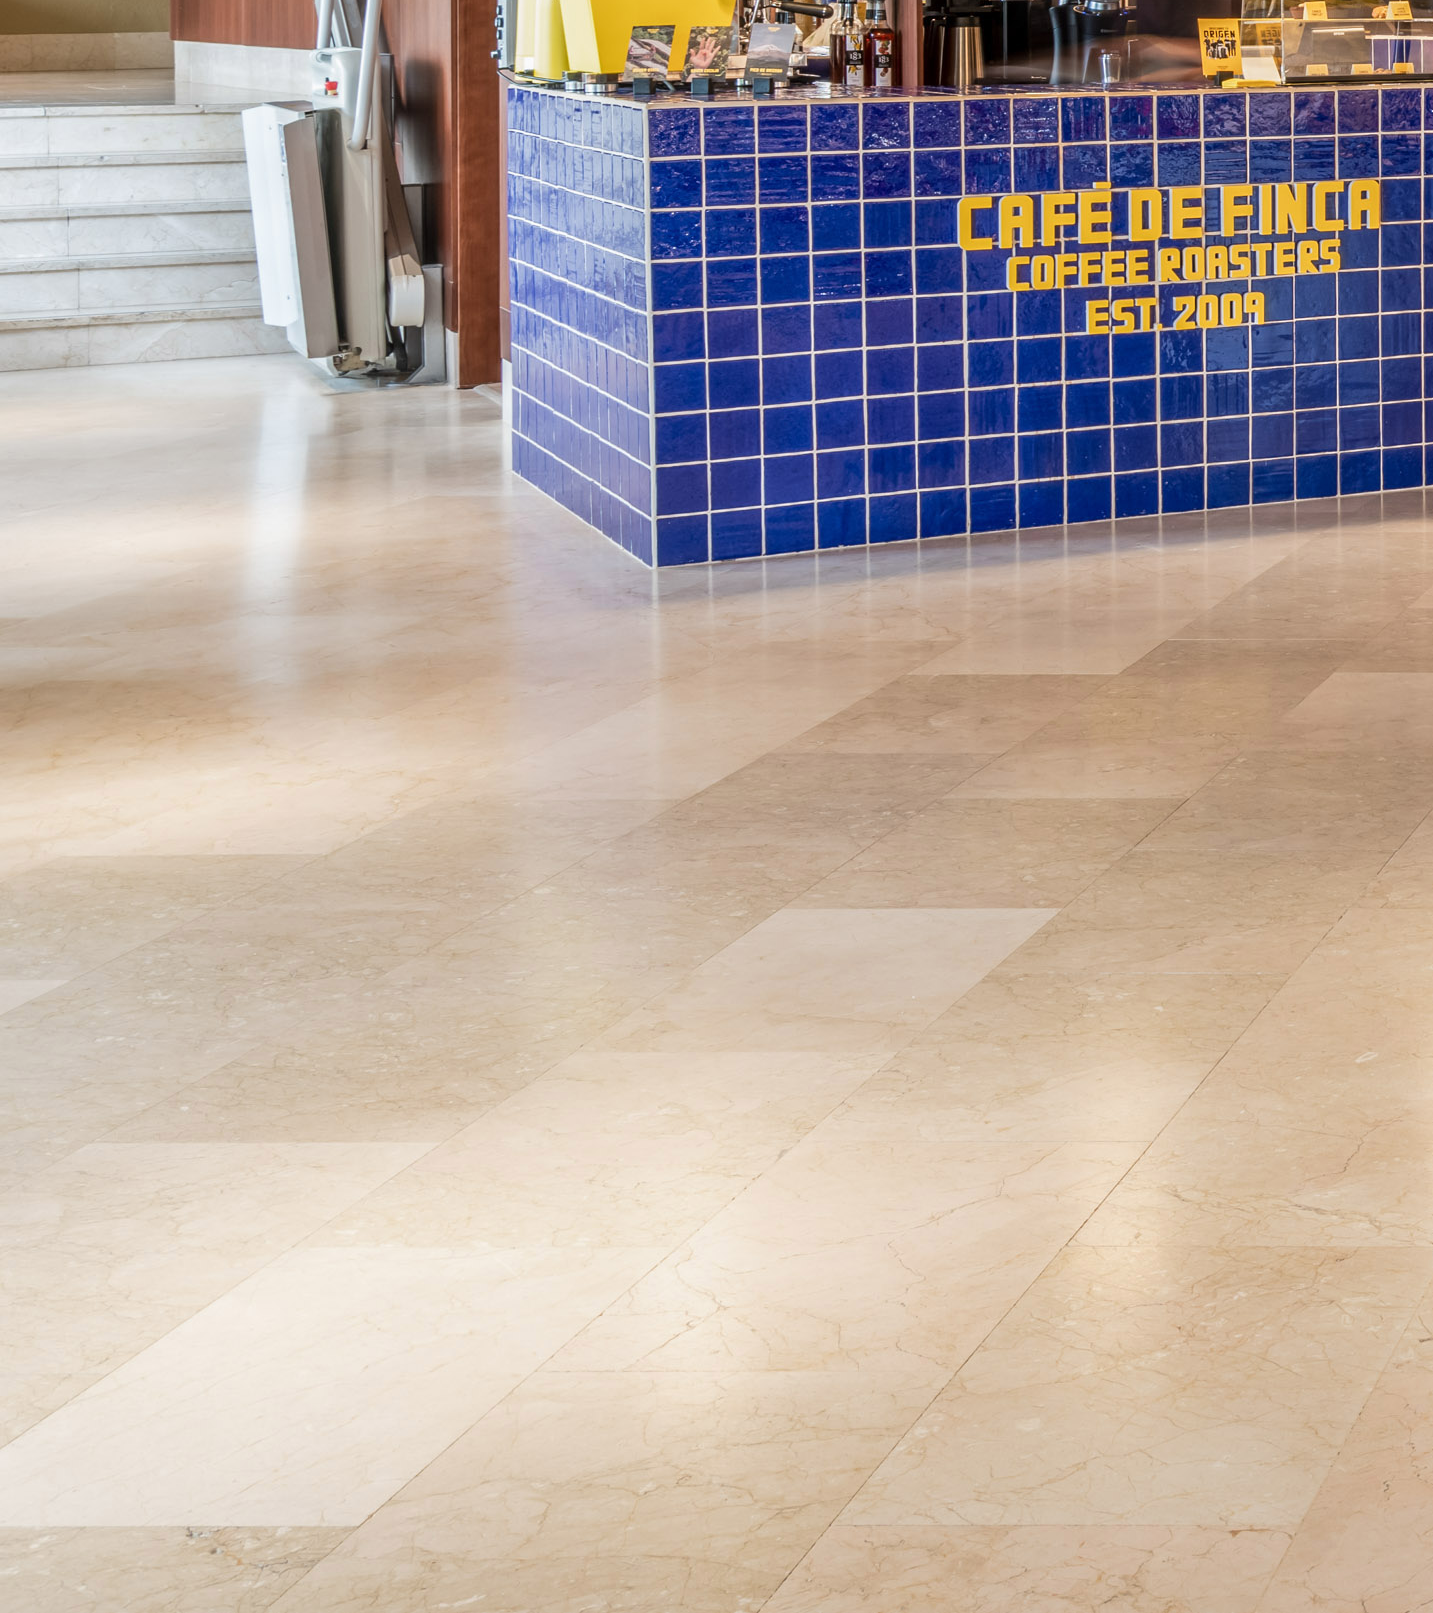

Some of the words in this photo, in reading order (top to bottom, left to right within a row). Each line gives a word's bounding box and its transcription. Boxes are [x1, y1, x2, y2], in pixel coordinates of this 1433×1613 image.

[957, 181, 1112, 251] CAFÉ
[1128, 187, 1203, 242] DE
[1220, 180, 1380, 237] FINCA
[1006, 249, 1149, 291] COFFEE
[1158, 239, 1341, 282] ROASTERS
[1086, 297, 1163, 335] EST.
[1172, 292, 1265, 331] 2009
